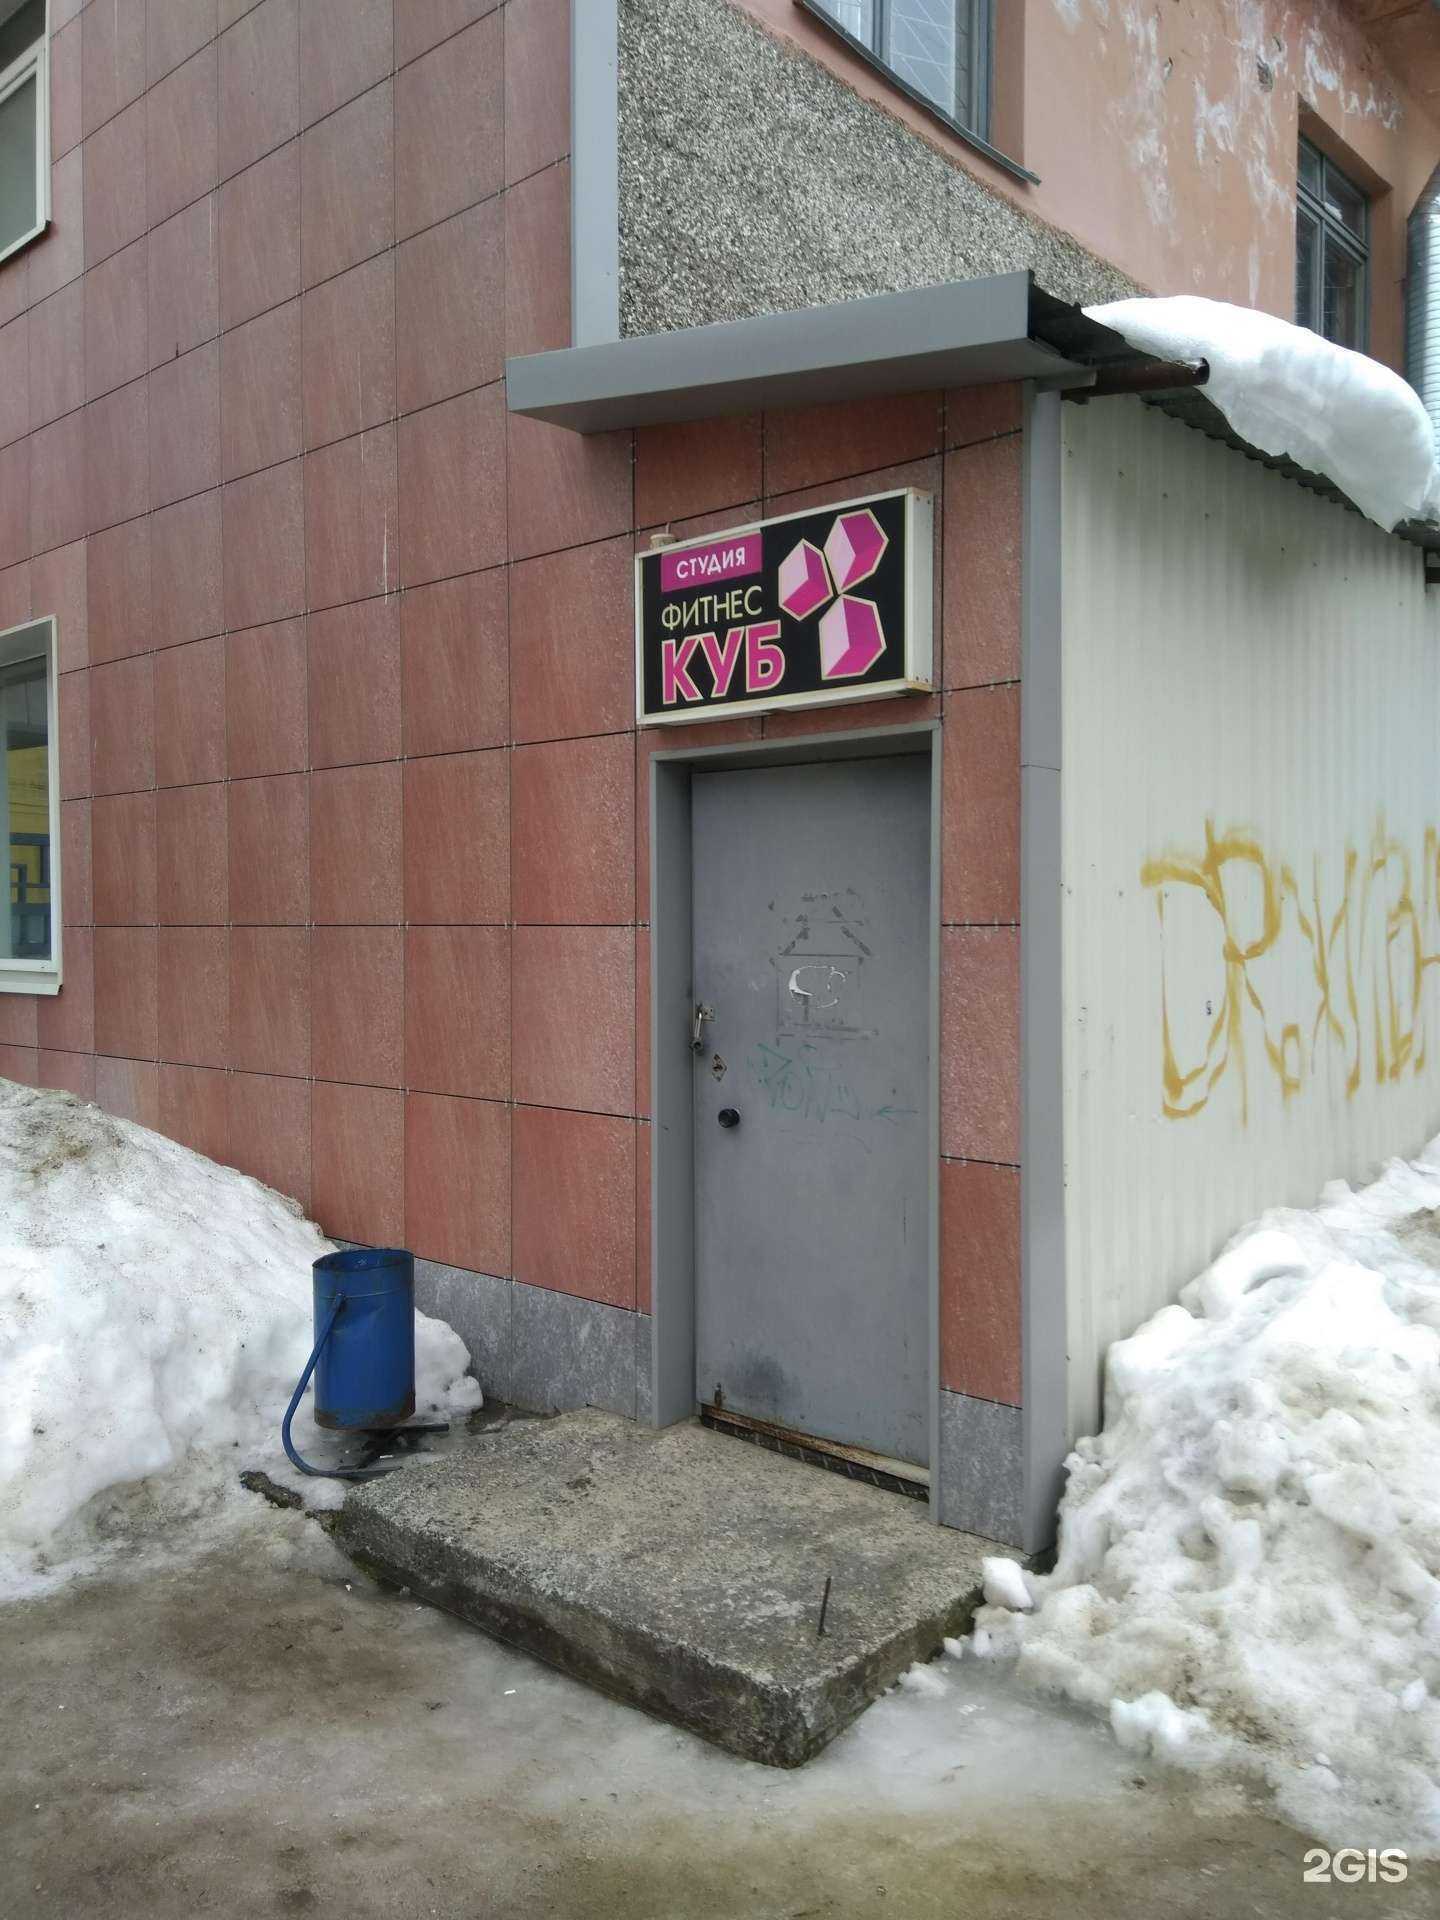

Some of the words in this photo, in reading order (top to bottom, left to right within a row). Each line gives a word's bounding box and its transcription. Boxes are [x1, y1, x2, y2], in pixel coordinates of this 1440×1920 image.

[676, 547, 746, 579] СТУДИЯ
[661, 585, 763, 630] ФИТНЕС
[661, 619, 786, 705] КУБ
